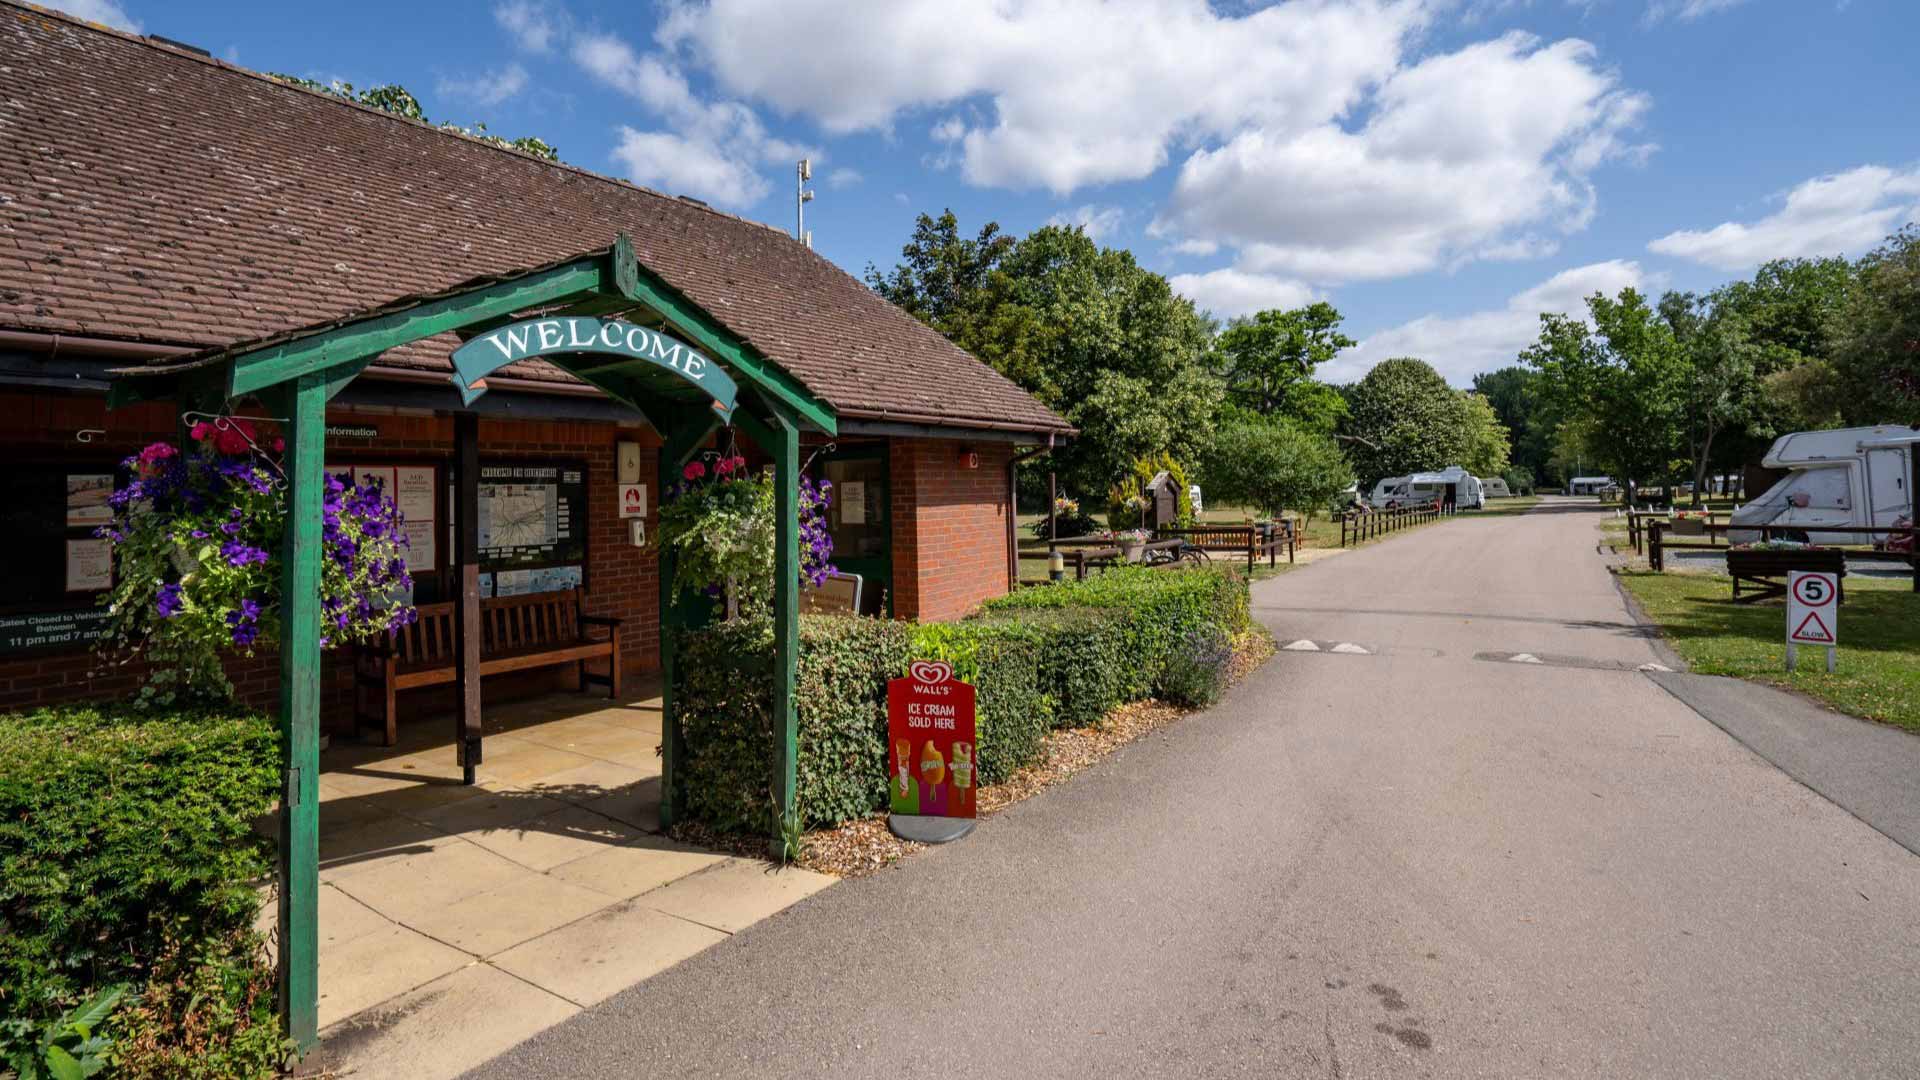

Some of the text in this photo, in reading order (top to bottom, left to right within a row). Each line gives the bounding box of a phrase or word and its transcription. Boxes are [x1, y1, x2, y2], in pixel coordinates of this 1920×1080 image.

[486, 319, 707, 380] WELCOME
[324, 426, 377, 437] nformation
[1804, 580, 1823, 601] 5
[0, 619, 26, 628] Gates
[28, 615, 61, 625] Closed
[63, 614, 73, 622] to
[36, 623, 77, 633] Between
[9, 630, 101, 647] 11 pm and 7 am
[913, 685, 949, 696] WALL'S
[908, 703, 955, 717] ICE CREAM
[908, 716, 956, 730] SOLD HERE
